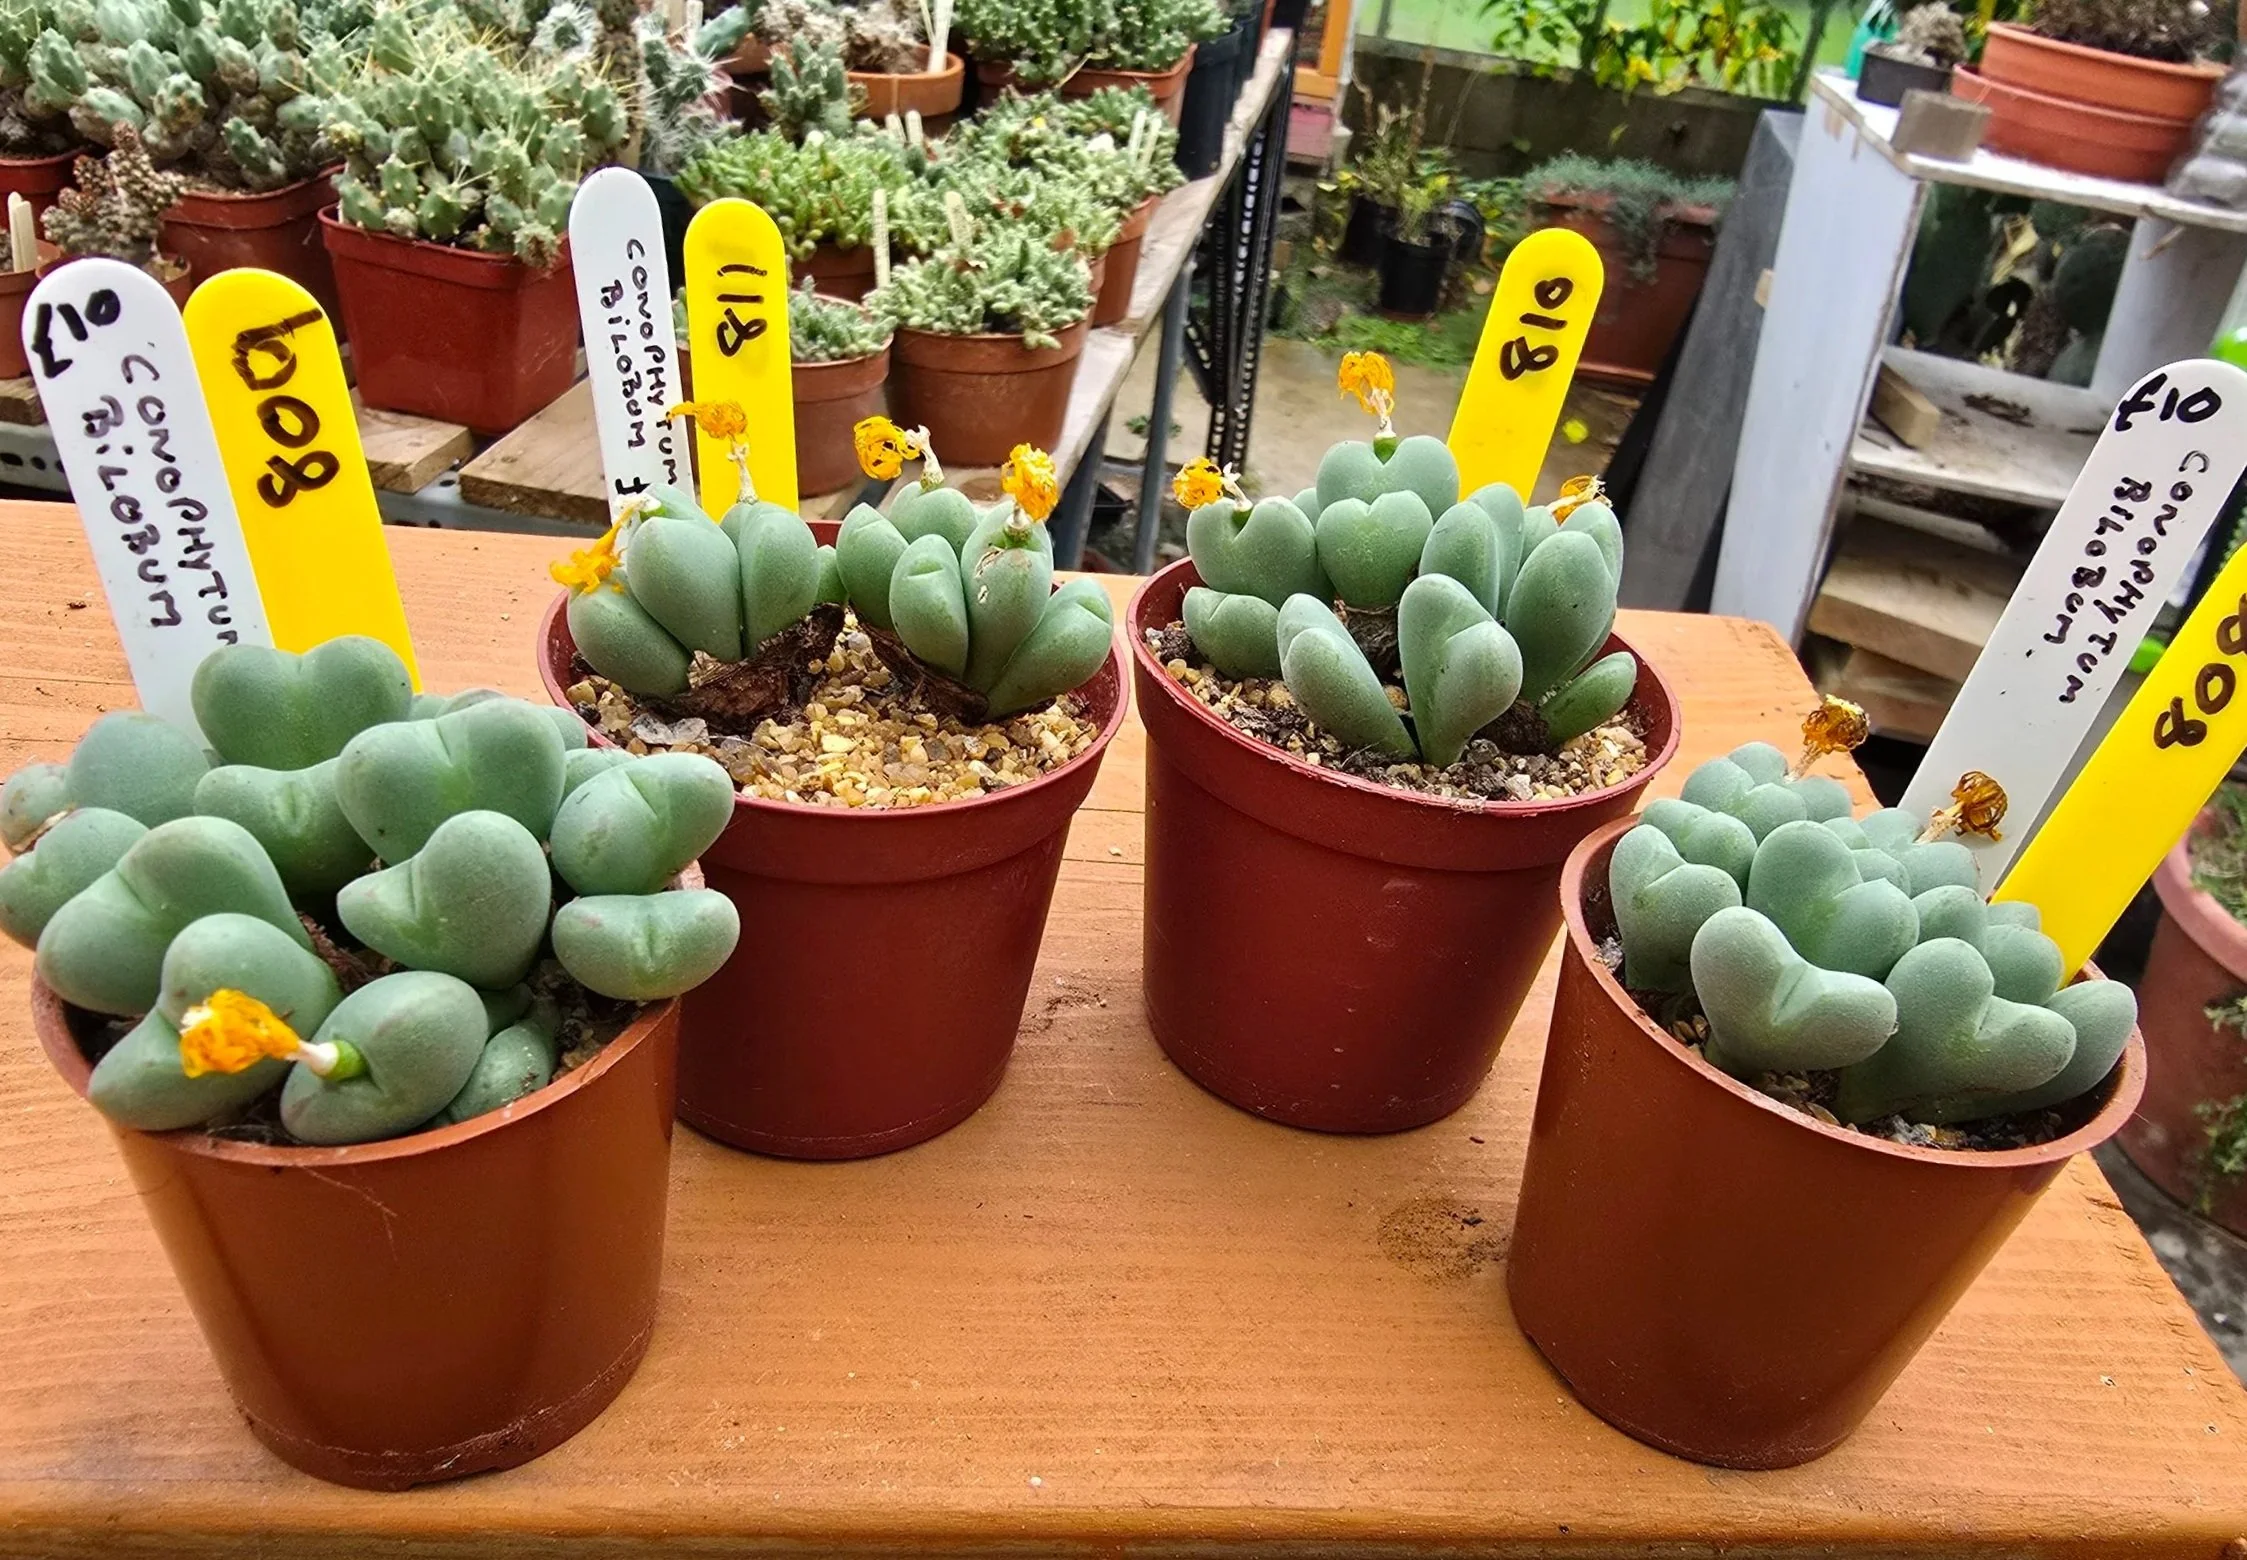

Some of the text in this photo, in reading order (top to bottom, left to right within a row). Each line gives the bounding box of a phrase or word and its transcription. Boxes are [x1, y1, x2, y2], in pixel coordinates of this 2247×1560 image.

[716, 264, 769, 358] 811
[1499, 276, 1575, 382] 810
[2114, 373, 2223, 432] £10
